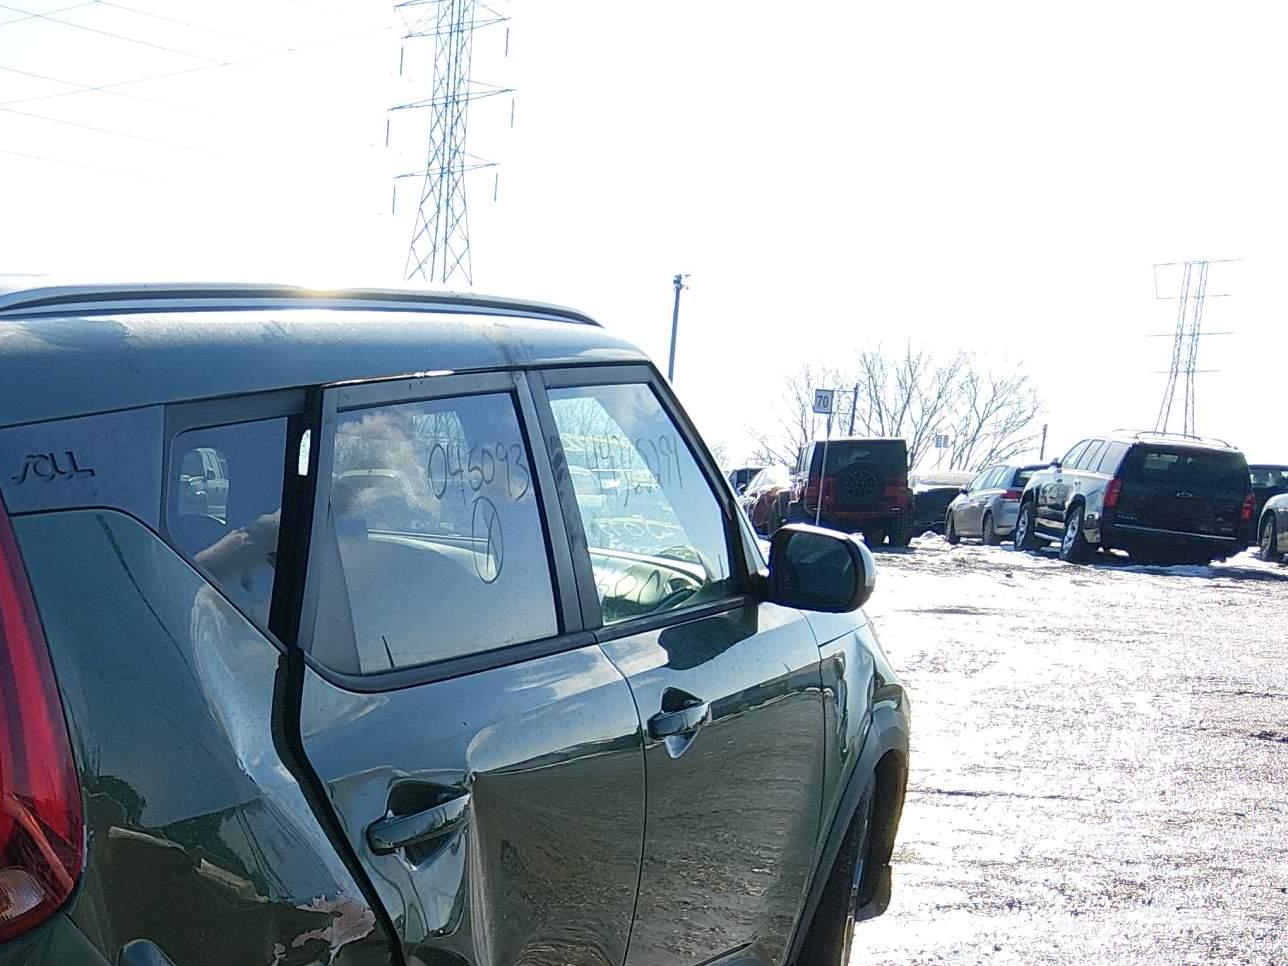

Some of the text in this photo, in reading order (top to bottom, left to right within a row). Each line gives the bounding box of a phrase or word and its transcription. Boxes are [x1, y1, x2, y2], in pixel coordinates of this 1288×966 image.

[816, 395, 829, 409] 70
[10, 450, 96, 485] SOUL
[427, 442, 530, 506] 045093
